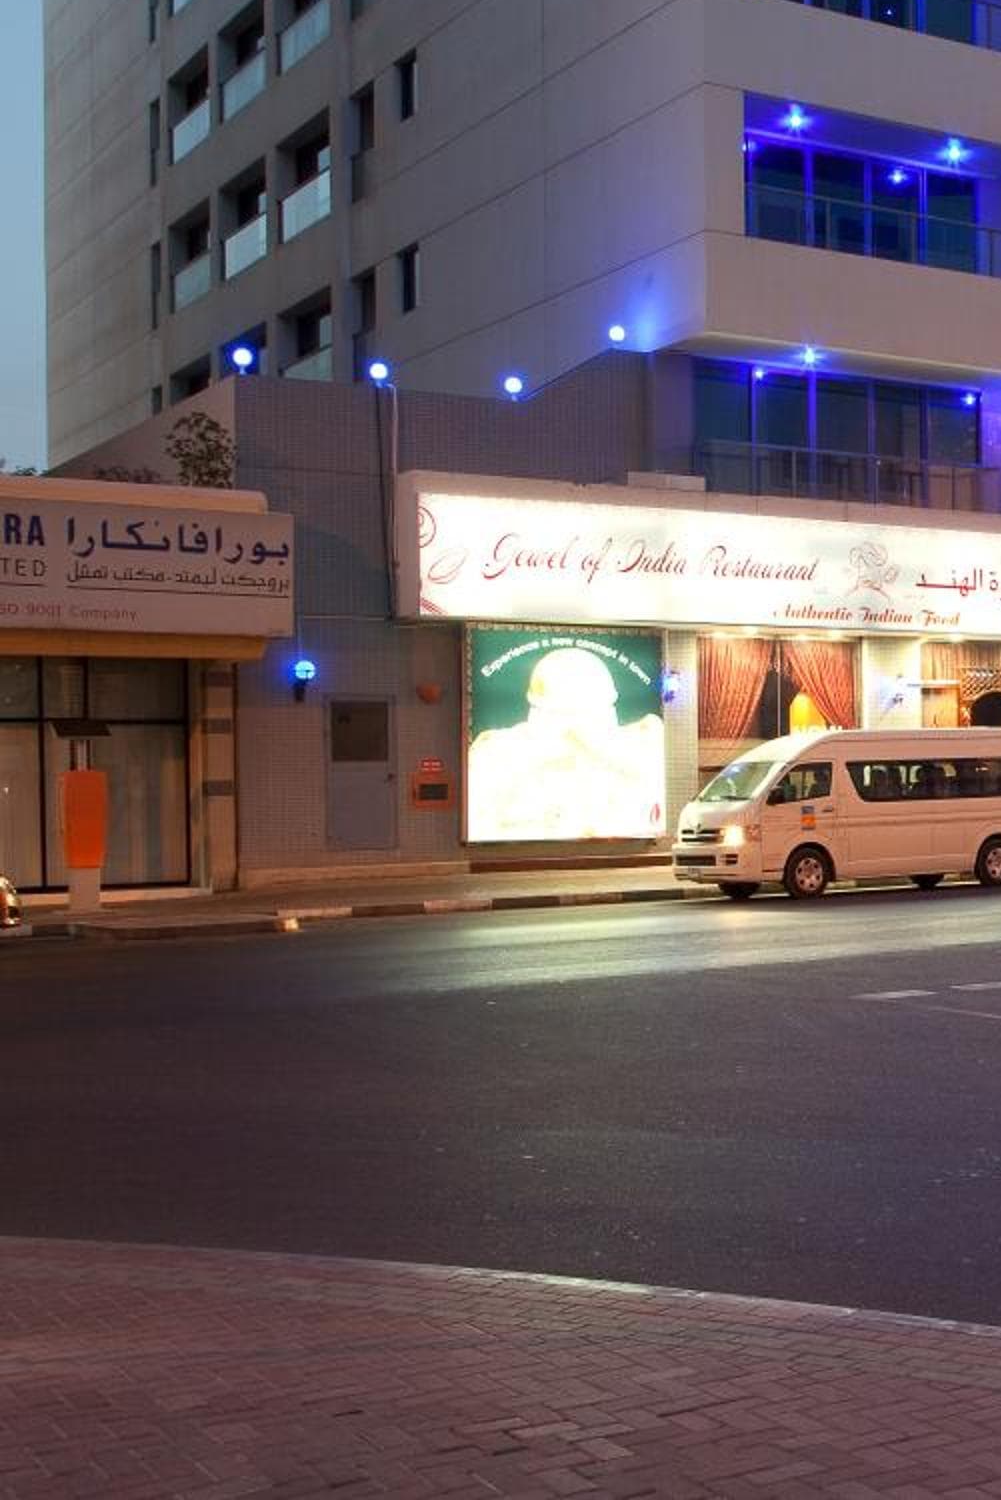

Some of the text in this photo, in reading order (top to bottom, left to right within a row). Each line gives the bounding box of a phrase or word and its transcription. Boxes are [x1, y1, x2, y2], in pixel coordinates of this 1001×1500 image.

[4, 513, 46, 548] RA
[580, 537, 614, 584] of
[617, 539, 688, 576] India
[700, 544, 819, 582] Restaurant
[915, 567, 984, 597] الهند
[481, 640, 540, 677] Experience
[551, 637, 575, 647] new
[576, 638, 618, 659] concept
[617, 653, 630, 666] in
[629, 661, 651, 686] town
